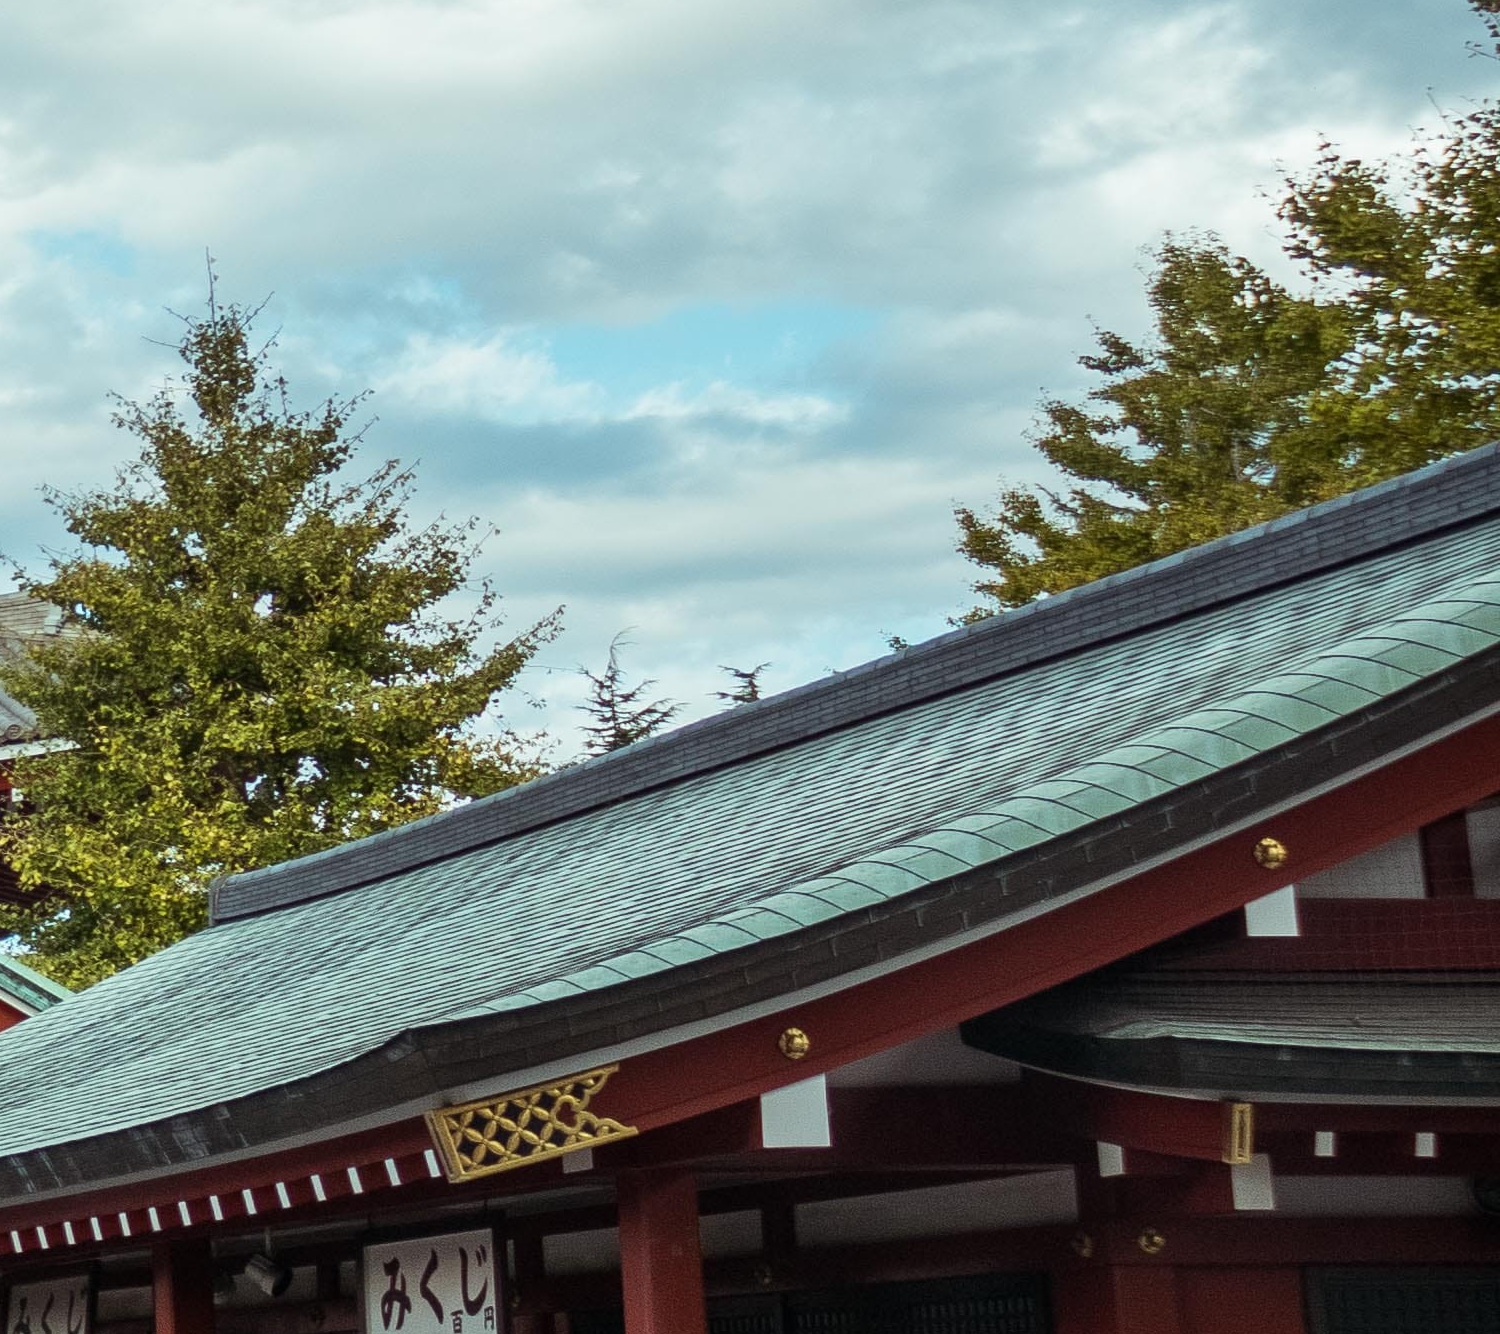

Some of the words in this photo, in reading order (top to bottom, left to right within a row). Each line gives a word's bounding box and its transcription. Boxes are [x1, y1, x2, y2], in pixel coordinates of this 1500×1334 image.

[381, 1244, 488, 1331] みくじ
[451, 1305, 495, 1334] 百円
